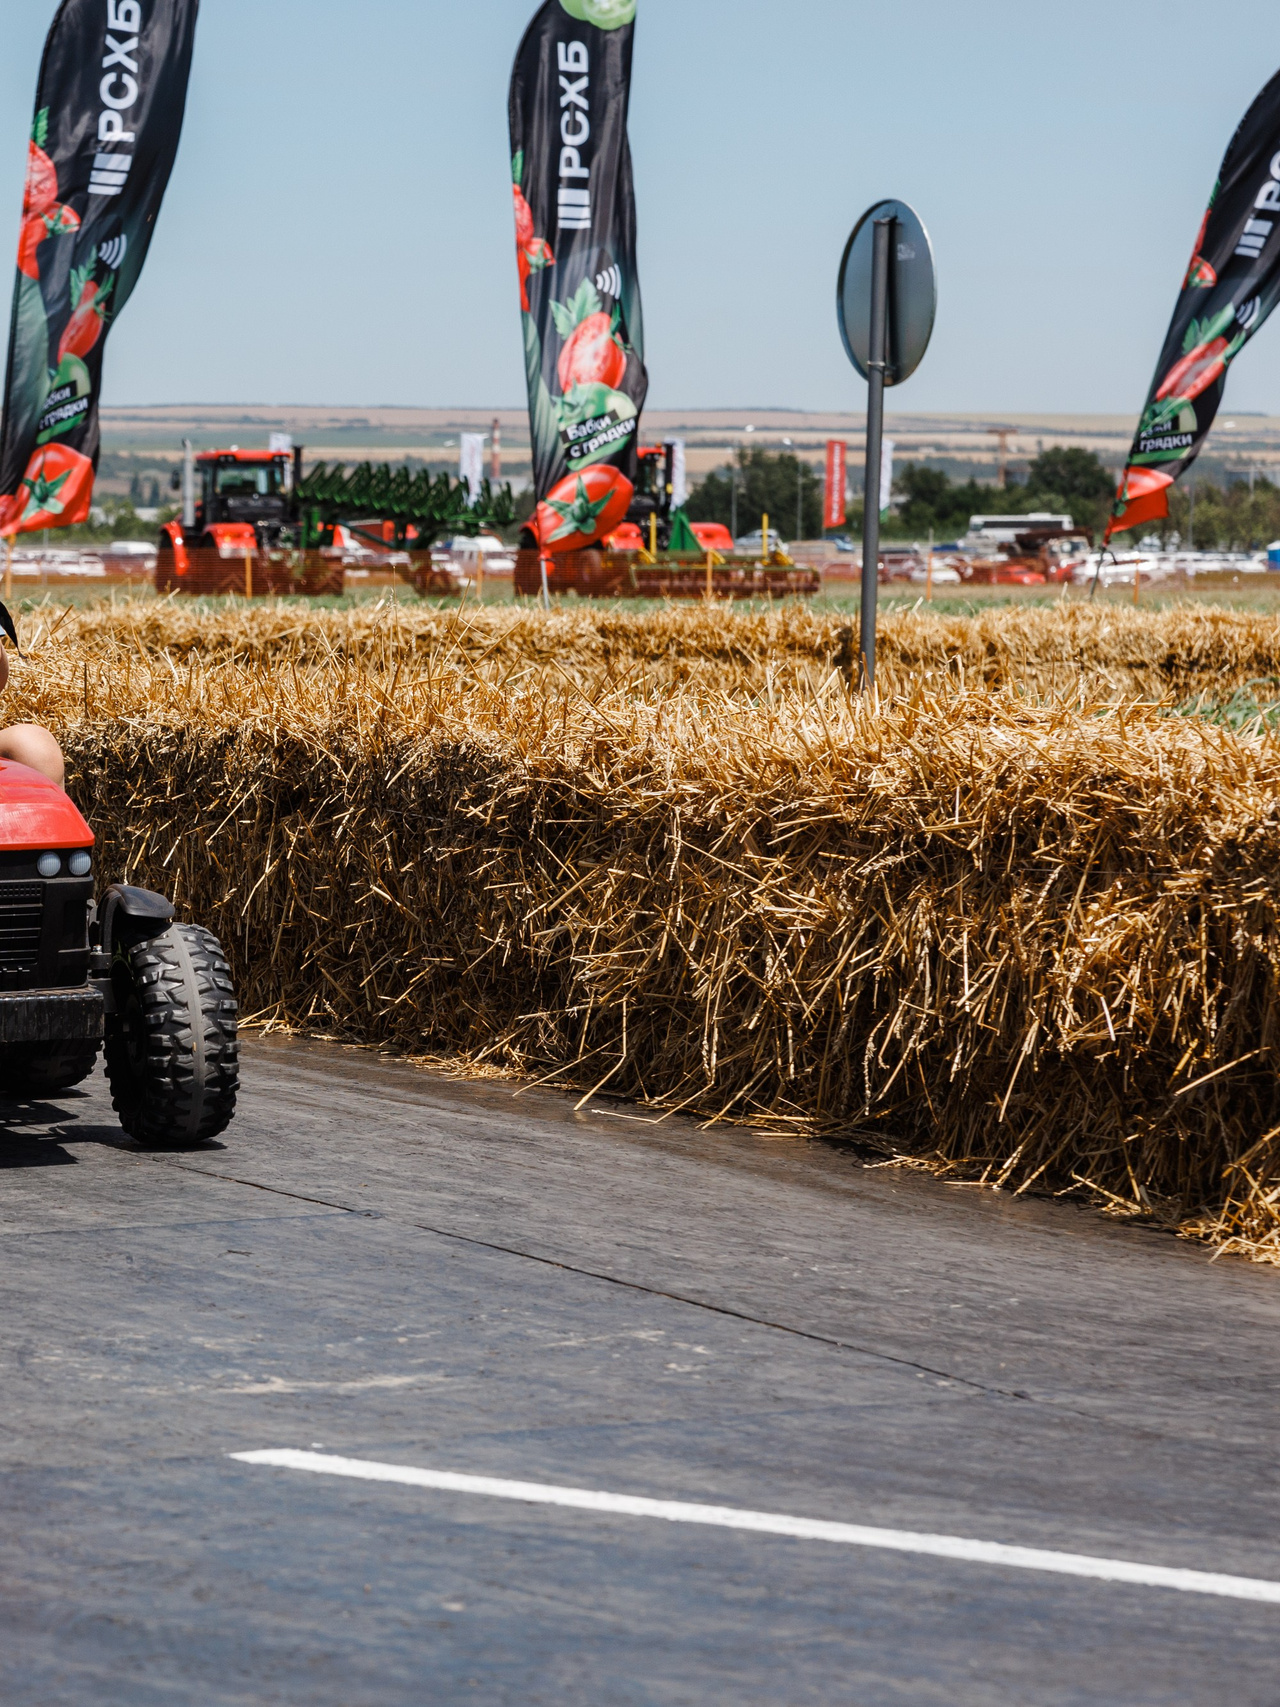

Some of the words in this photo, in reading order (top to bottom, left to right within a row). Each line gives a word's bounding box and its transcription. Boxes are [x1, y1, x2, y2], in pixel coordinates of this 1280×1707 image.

[98, 0, 141, 142] РСХБ
[557, 40, 590, 178] РСХБ
[566, 415, 612, 440] Бабки
[570, 445, 581, 458] с
[582, 418, 636, 454] грядки
[1140, 433, 1193, 453] грядки
